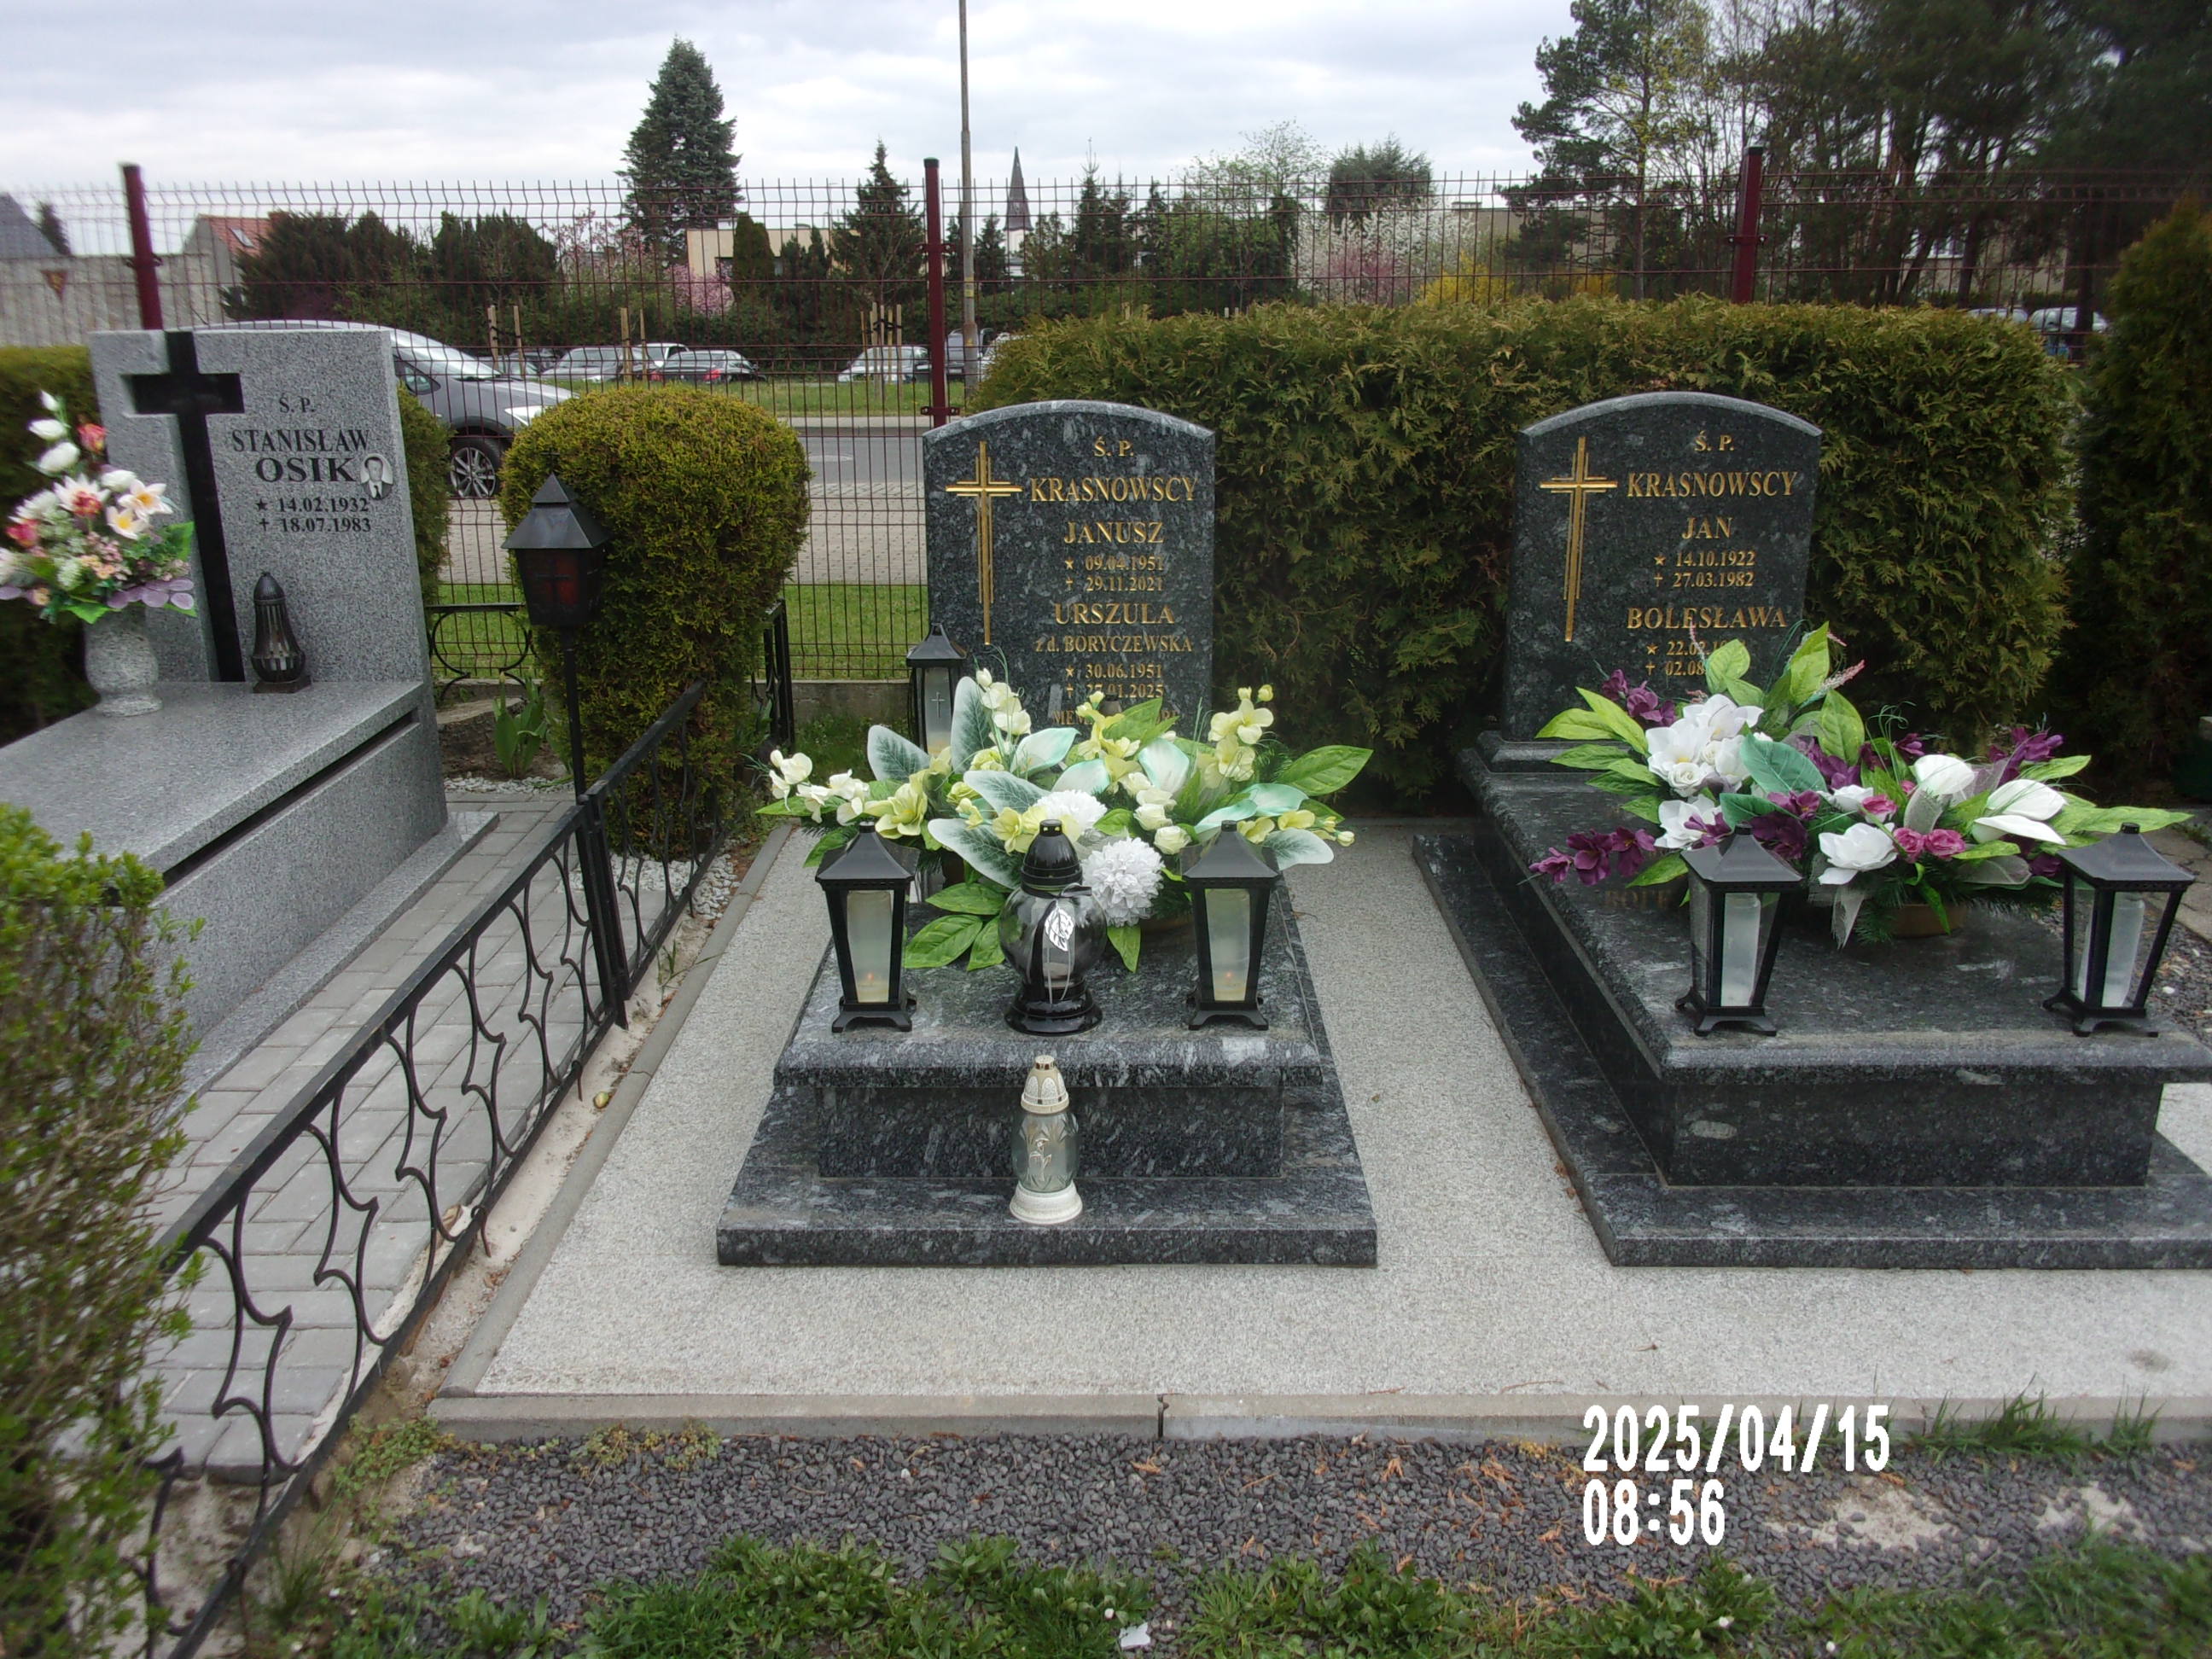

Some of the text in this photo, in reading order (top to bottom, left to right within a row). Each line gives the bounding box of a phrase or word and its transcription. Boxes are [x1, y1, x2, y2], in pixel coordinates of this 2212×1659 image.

[298, 396, 316, 414] P.
[1094, 436, 1135, 457] Ś. P.
[1695, 430, 1735, 451] Ś. P.
[256, 457, 357, 483] OSIK
[1030, 476, 1199, 502] KRASNOWSCY
[1627, 471, 1798, 498] KRASNOWSCY
[277, 497, 370, 512] 14.02.1932
[281, 517, 371, 533] 18.07.1983
[1063, 521, 1165, 544] JANUSZ
[1681, 516, 1733, 540] JAN
[1085, 555, 1165, 571] 09.04.1951
[1675, 550, 1756, 567] 14.10.1922
[1086, 575, 1164, 591] 29.11.2021
[1673, 571, 1755, 588] 27.03.1982
[1054, 602, 1175, 625] URSZULA
[1626, 606, 1790, 630] BOLESŁAWA
[1046, 635, 1060, 653] d.
[1064, 635, 1193, 653] BORYCZEWSKA
[1085, 663, 1163, 679] 30.06.1951
